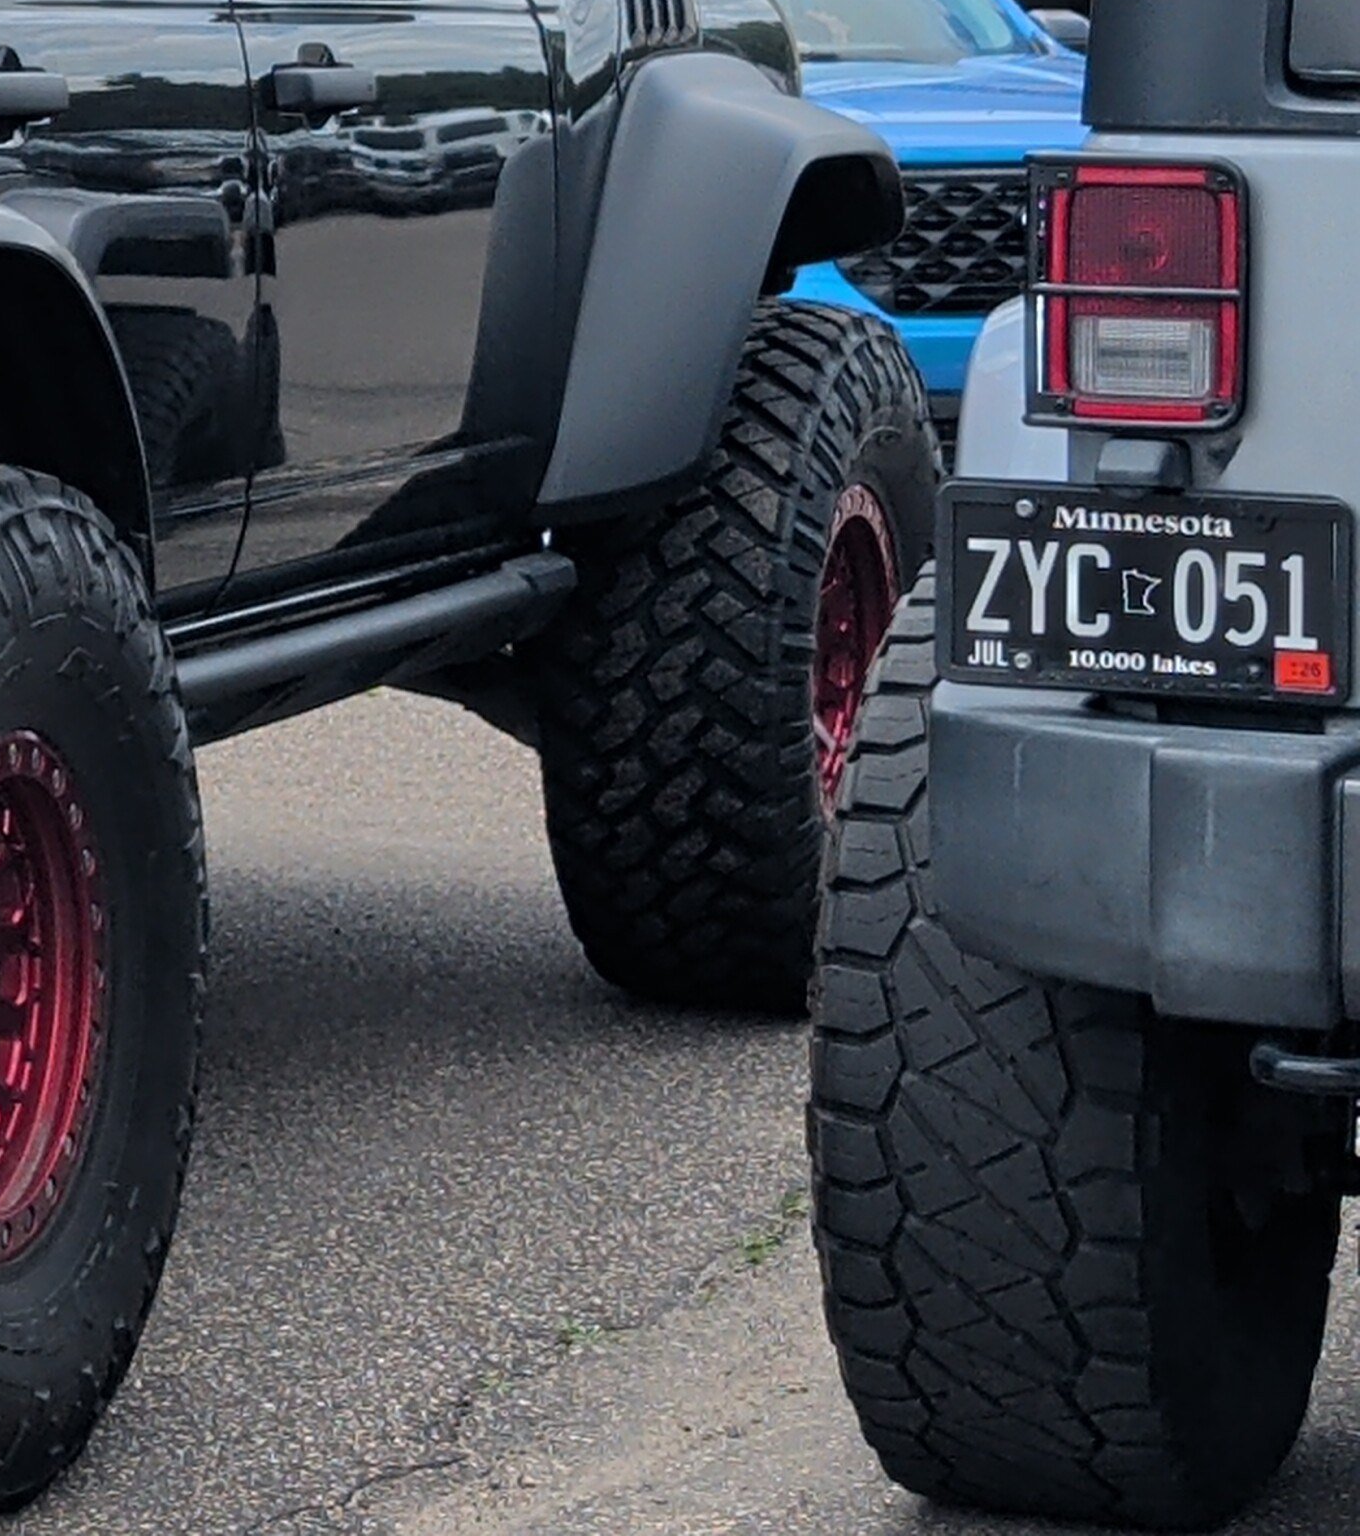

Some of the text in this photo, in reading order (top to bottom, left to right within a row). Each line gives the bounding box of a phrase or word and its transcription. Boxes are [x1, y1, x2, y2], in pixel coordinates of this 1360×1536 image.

[1053, 504, 1234, 540] Minnesota
[966, 538, 1319, 653] ZYC 051
[968, 639, 1009, 668] JUL
[1152, 653, 1218, 676] lakes
